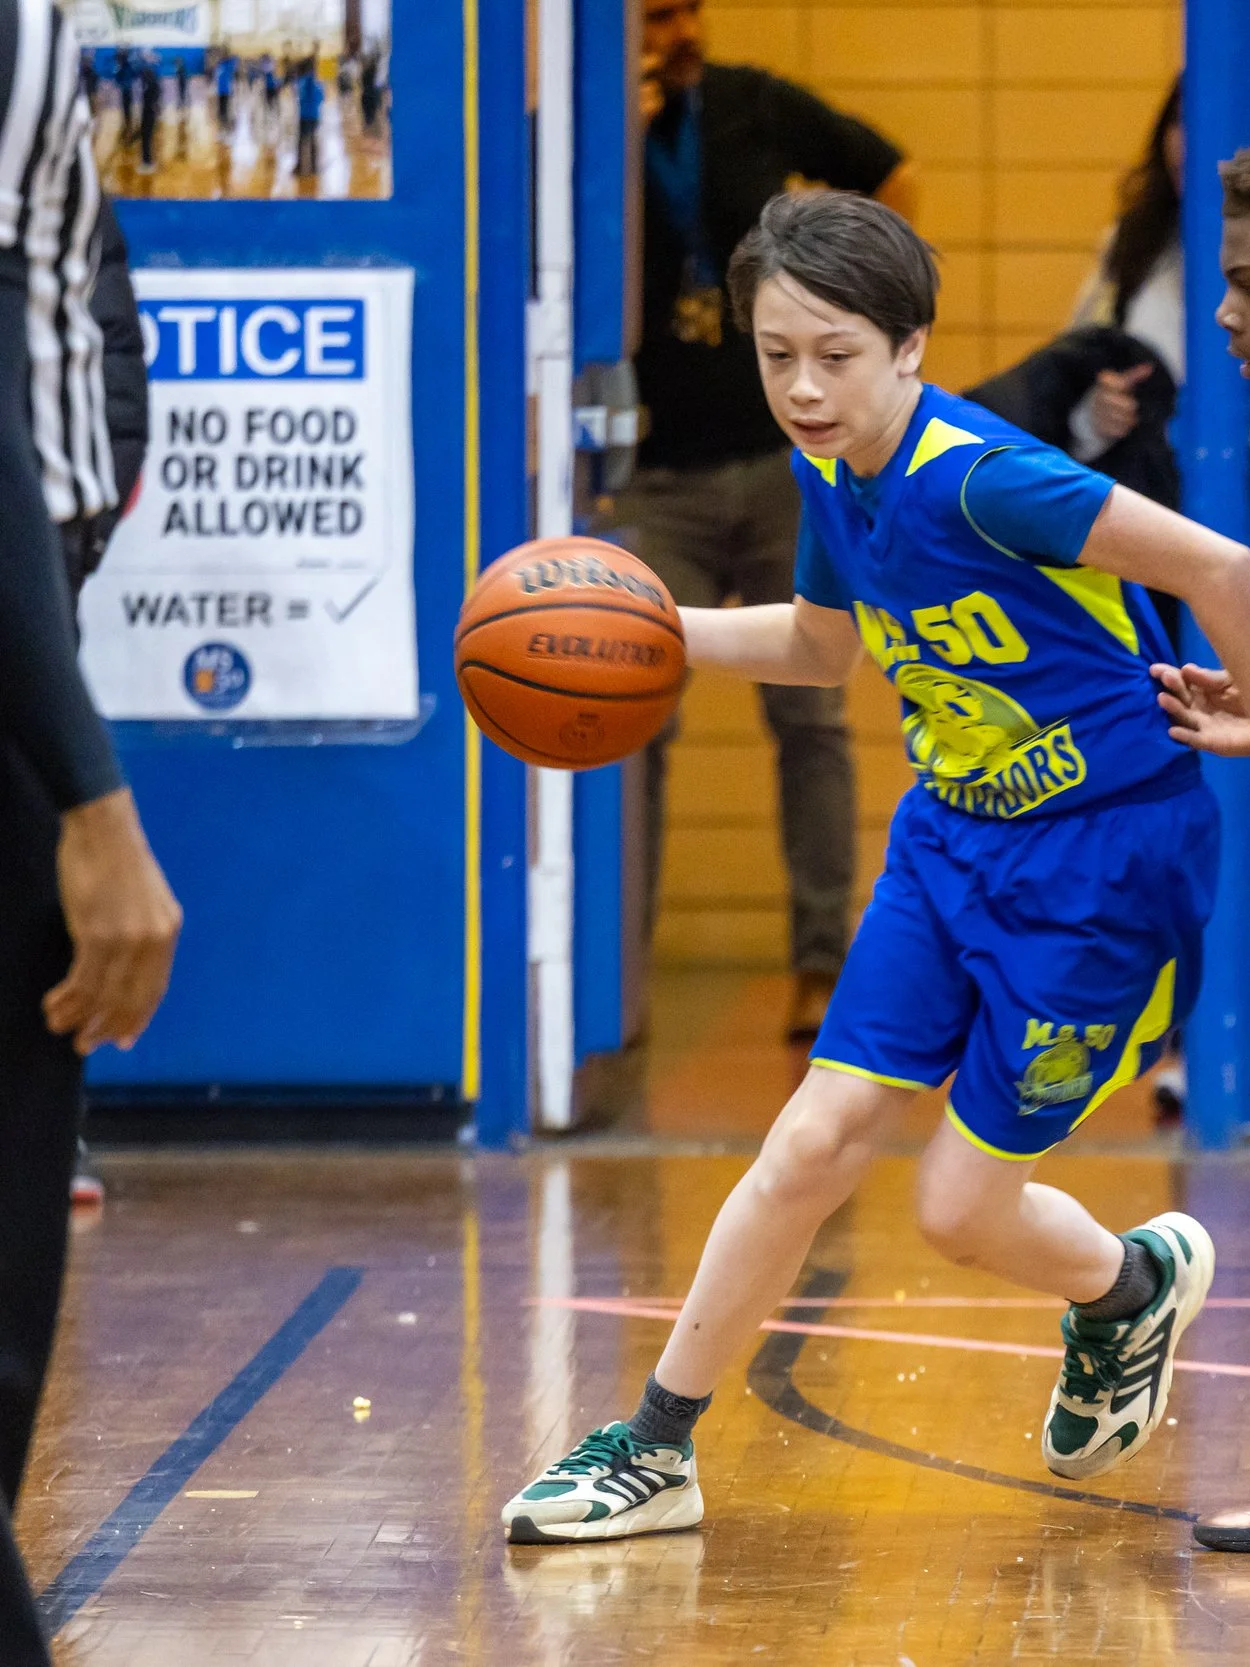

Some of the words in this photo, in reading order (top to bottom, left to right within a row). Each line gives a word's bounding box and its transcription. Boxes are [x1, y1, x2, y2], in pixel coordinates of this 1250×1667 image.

[169, 407, 229, 446] NO
[245, 407, 358, 446] FOOD
[161, 453, 217, 491] OR
[235, 453, 365, 491] DRINK
[162, 499, 365, 538] ALLOWED
[122, 591, 273, 628] WATER
[911, 590, 1029, 665] 50
